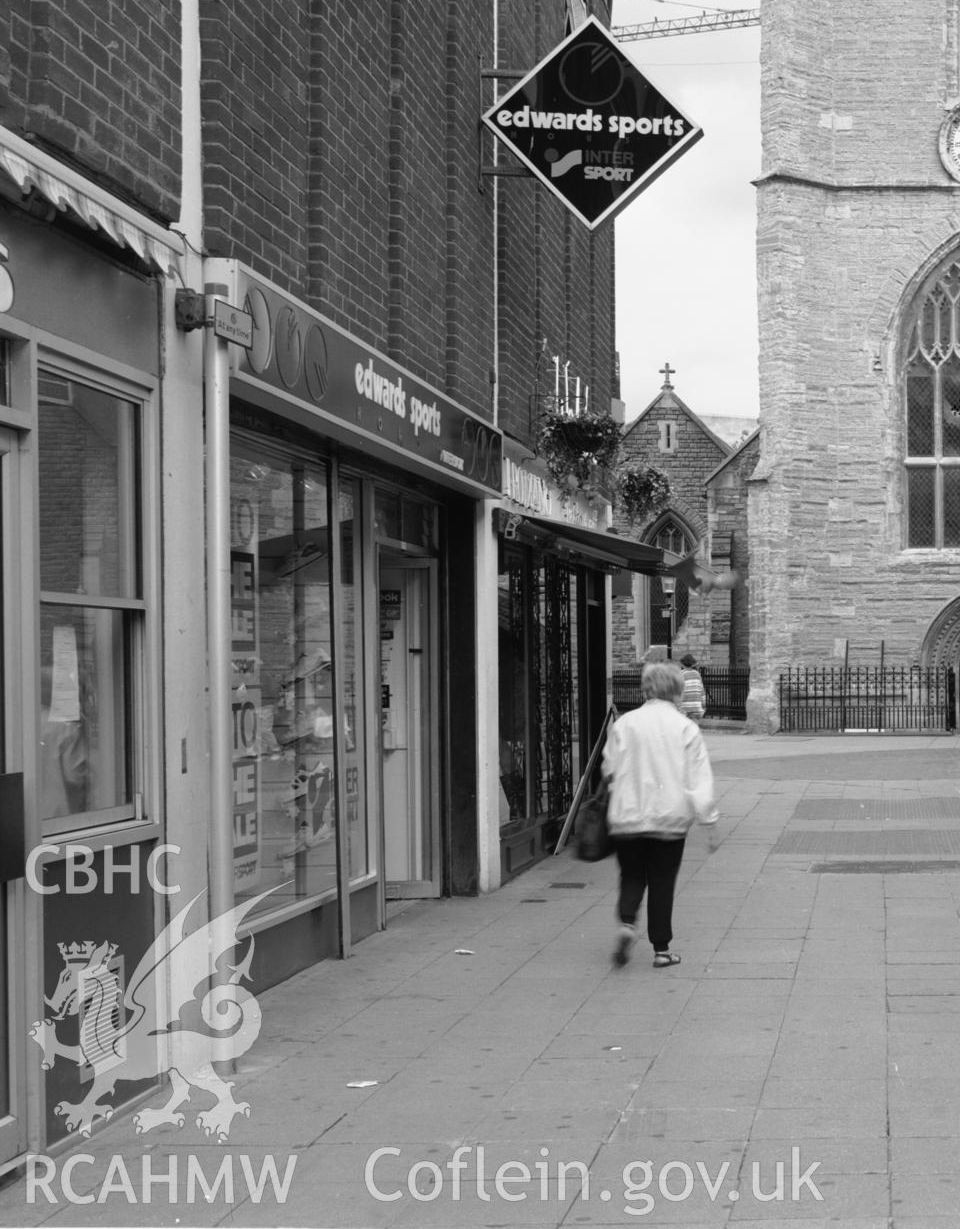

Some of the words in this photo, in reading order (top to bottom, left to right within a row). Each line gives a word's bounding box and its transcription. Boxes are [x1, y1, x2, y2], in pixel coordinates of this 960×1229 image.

[497, 105, 602, 132] edwards
[609, 115, 684, 139] sports
[585, 149, 634, 165] INTER
[584, 166, 634, 181] SPORT
[355, 358, 407, 419] edwards
[410, 396, 441, 437] sports
